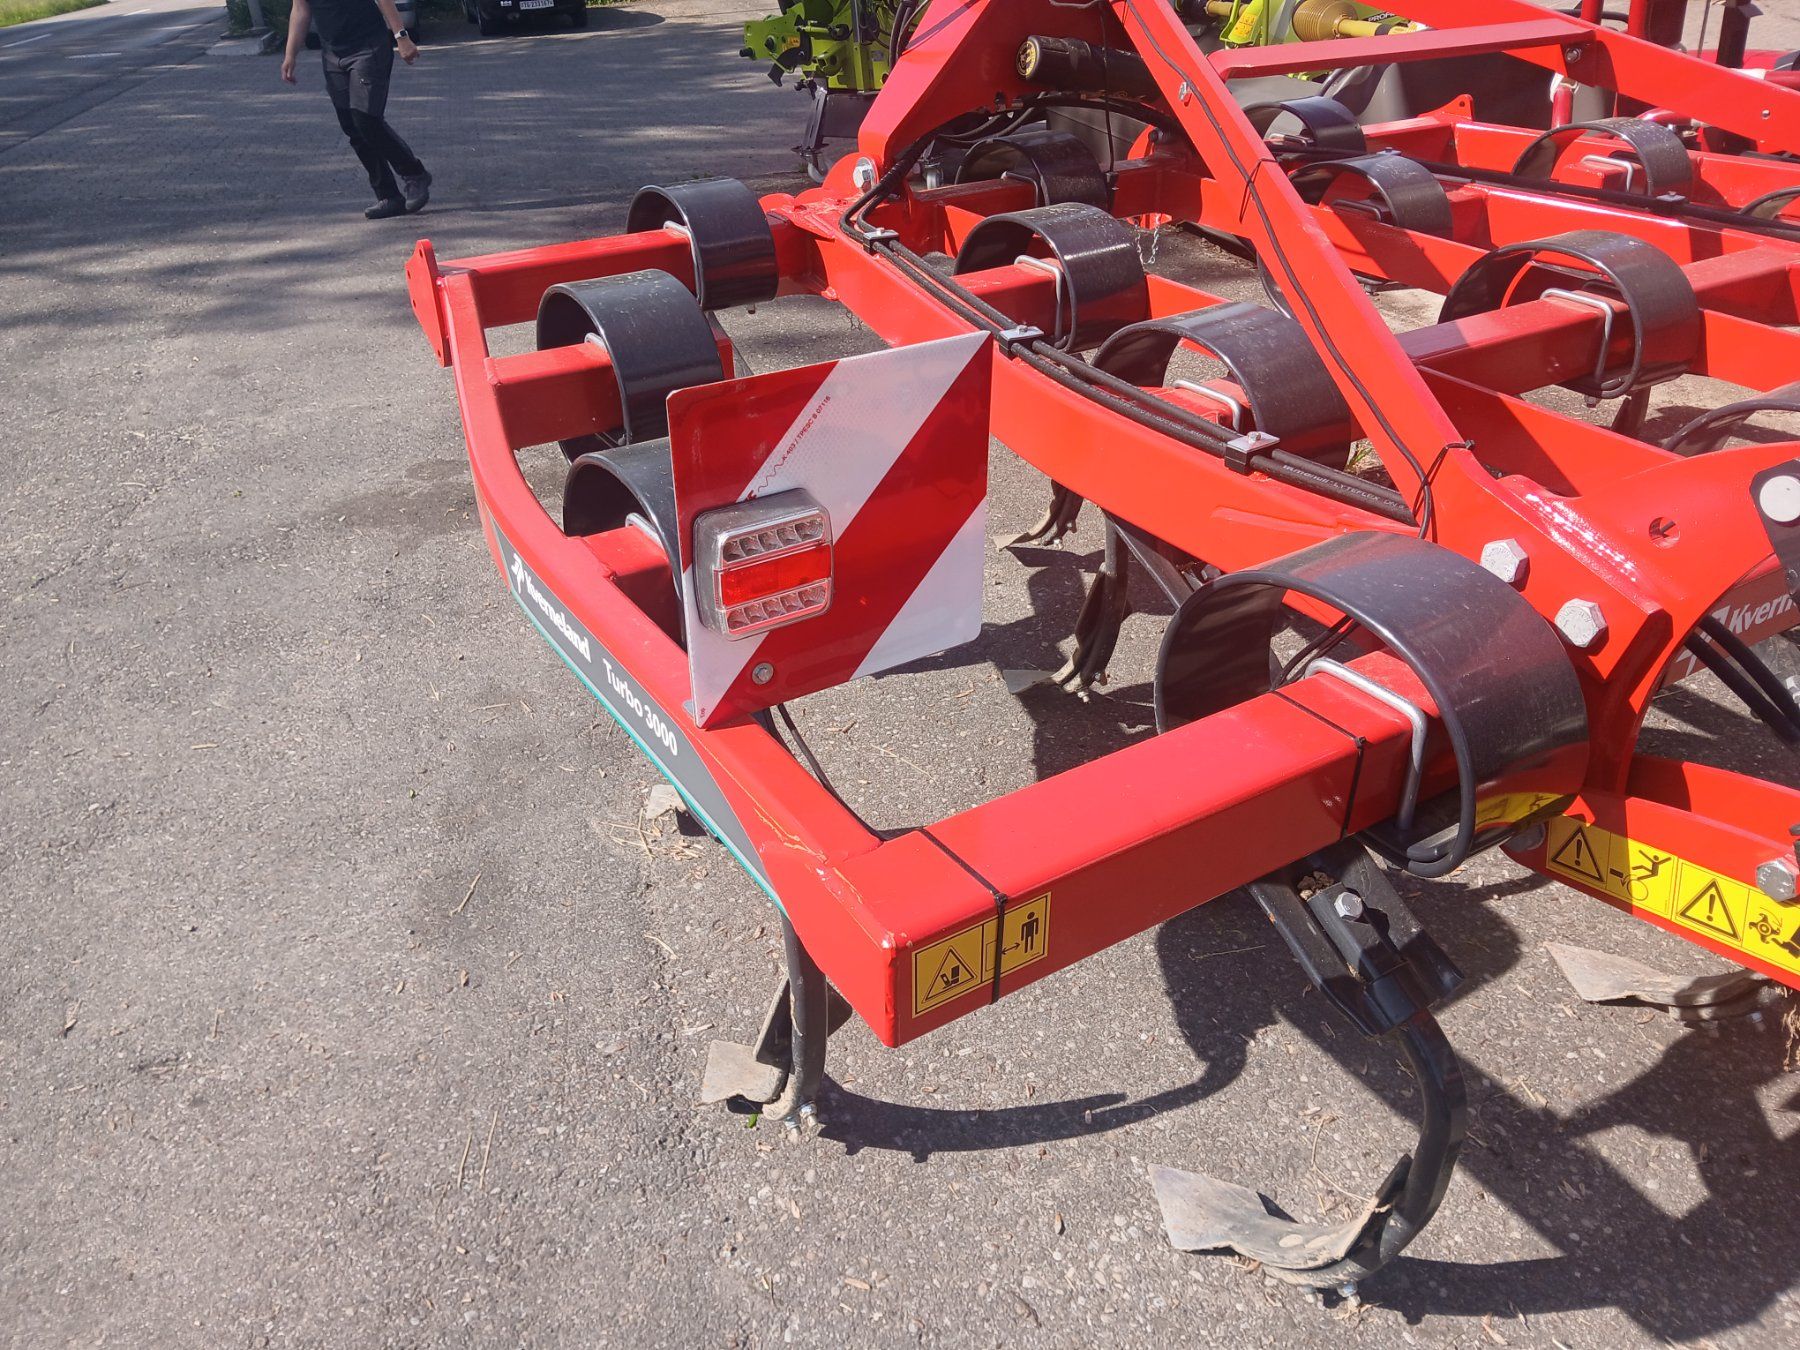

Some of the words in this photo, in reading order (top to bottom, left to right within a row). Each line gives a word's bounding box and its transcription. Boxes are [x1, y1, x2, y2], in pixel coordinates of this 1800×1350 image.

[524, 569, 592, 663] Kverneland
[602, 658, 643, 717] Turbo
[644, 704, 678, 756] 3000
[1729, 593, 1797, 634] Kvern
